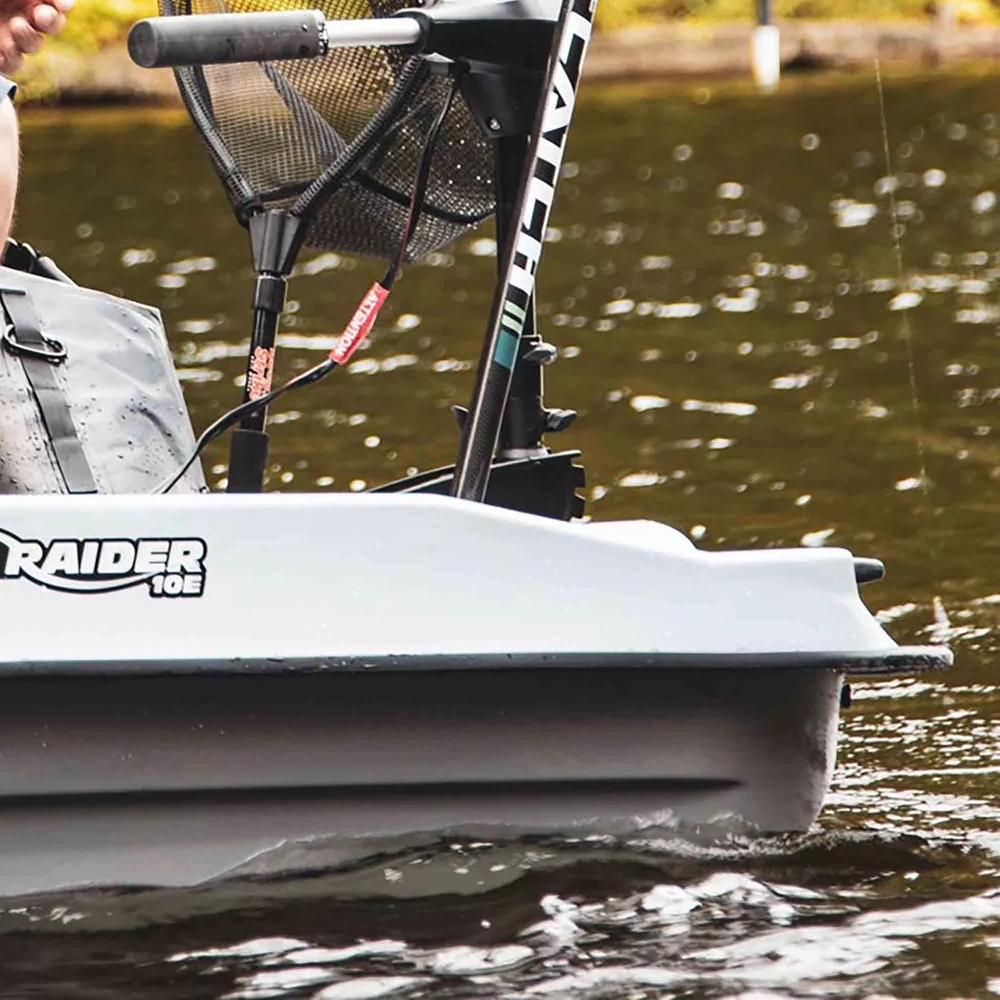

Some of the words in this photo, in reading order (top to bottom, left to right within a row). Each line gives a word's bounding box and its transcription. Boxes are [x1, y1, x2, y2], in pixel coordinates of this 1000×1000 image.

[333, 289, 380, 357] ATTENTION
[4, 538, 207, 580] RAIDER
[150, 573, 205, 597] 10E
